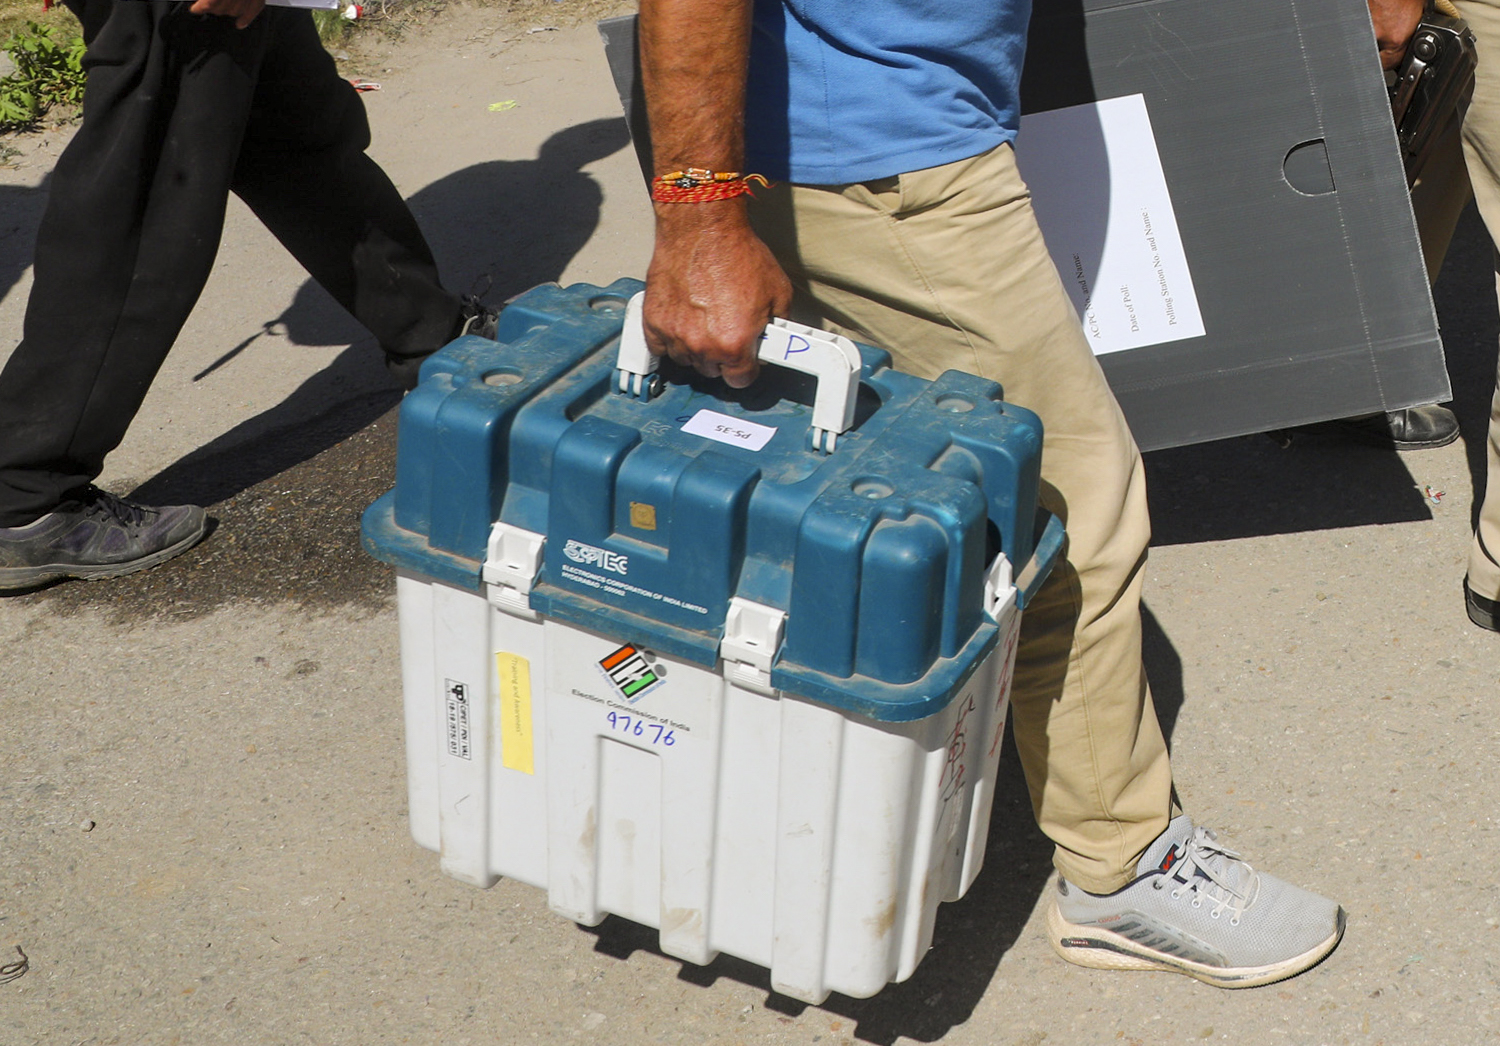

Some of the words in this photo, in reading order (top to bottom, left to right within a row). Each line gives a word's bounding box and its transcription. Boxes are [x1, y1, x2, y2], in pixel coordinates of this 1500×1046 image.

[1142, 212, 1153, 236] Name
[1147, 237, 1157, 252] and
[1073, 253, 1085, 279] Name:
[1153, 253, 1162, 269] No.
[1078, 280, 1089, 295] and
[1157, 268, 1169, 297] Station
[1083, 296, 1094, 311] No.
[1120, 284, 1131, 303] Poll:
[1124, 304, 1134, 313] of
[1165, 297, 1177, 326] Polling
[1086, 312, 1101, 339] AC/PC
[1130, 314, 1139, 332] Date
[783, 334, 811, 360] P
[715, 424, 752, 440] PS-35
[561, 571, 600, 589] HYDERABAD
[562, 564, 606, 583] ELECTRONICS
[605, 578, 653, 598] CORPORATION
[662, 596, 681, 607] INDIA
[681, 601, 708, 615] LIMITED
[571, 688, 605, 705] Election
[606, 700, 658, 722] Commission
[669, 720, 691, 732] India
[606, 711, 676, 746] 97676
